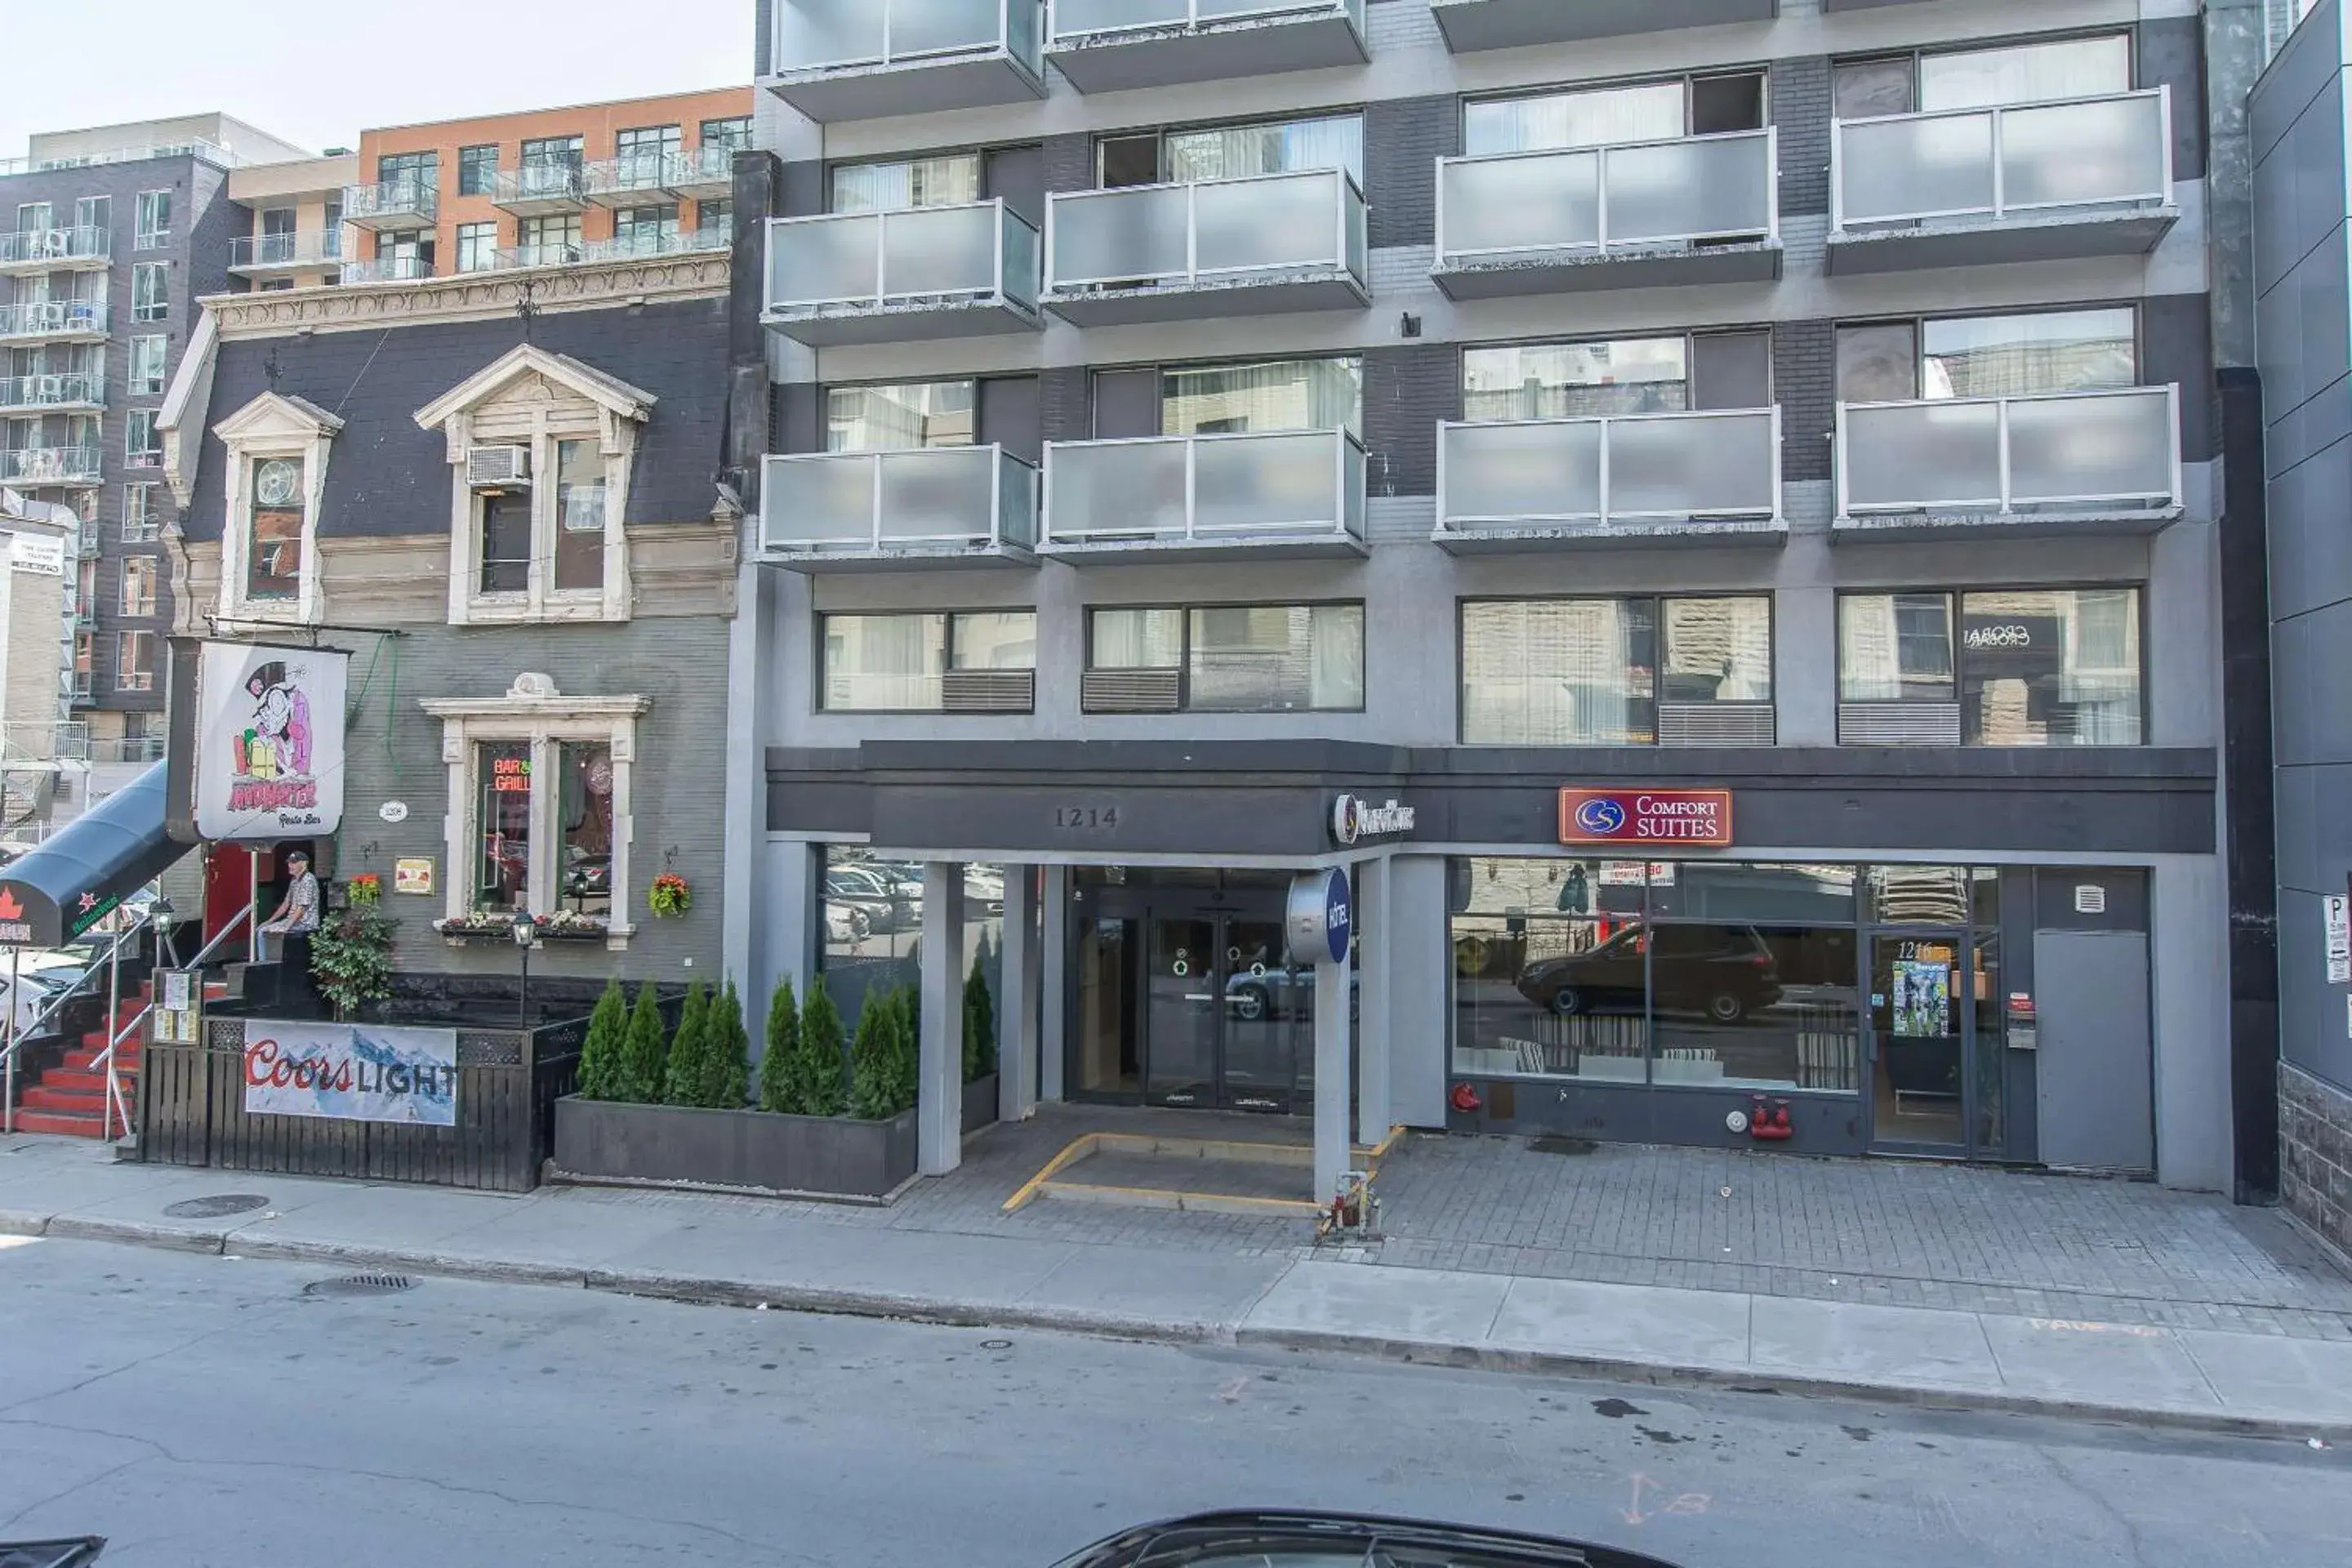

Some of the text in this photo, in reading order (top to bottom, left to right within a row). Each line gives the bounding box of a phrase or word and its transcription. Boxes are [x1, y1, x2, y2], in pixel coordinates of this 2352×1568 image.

[496, 776, 531, 791] GRILL
[1056, 807, 1118, 828] 1214
[1637, 817, 1717, 837] SUITES
[2332, 898, 2341, 921] P
[1897, 942, 1933, 960] 1216
[245, 1040, 459, 1096] Coors LIGHT
